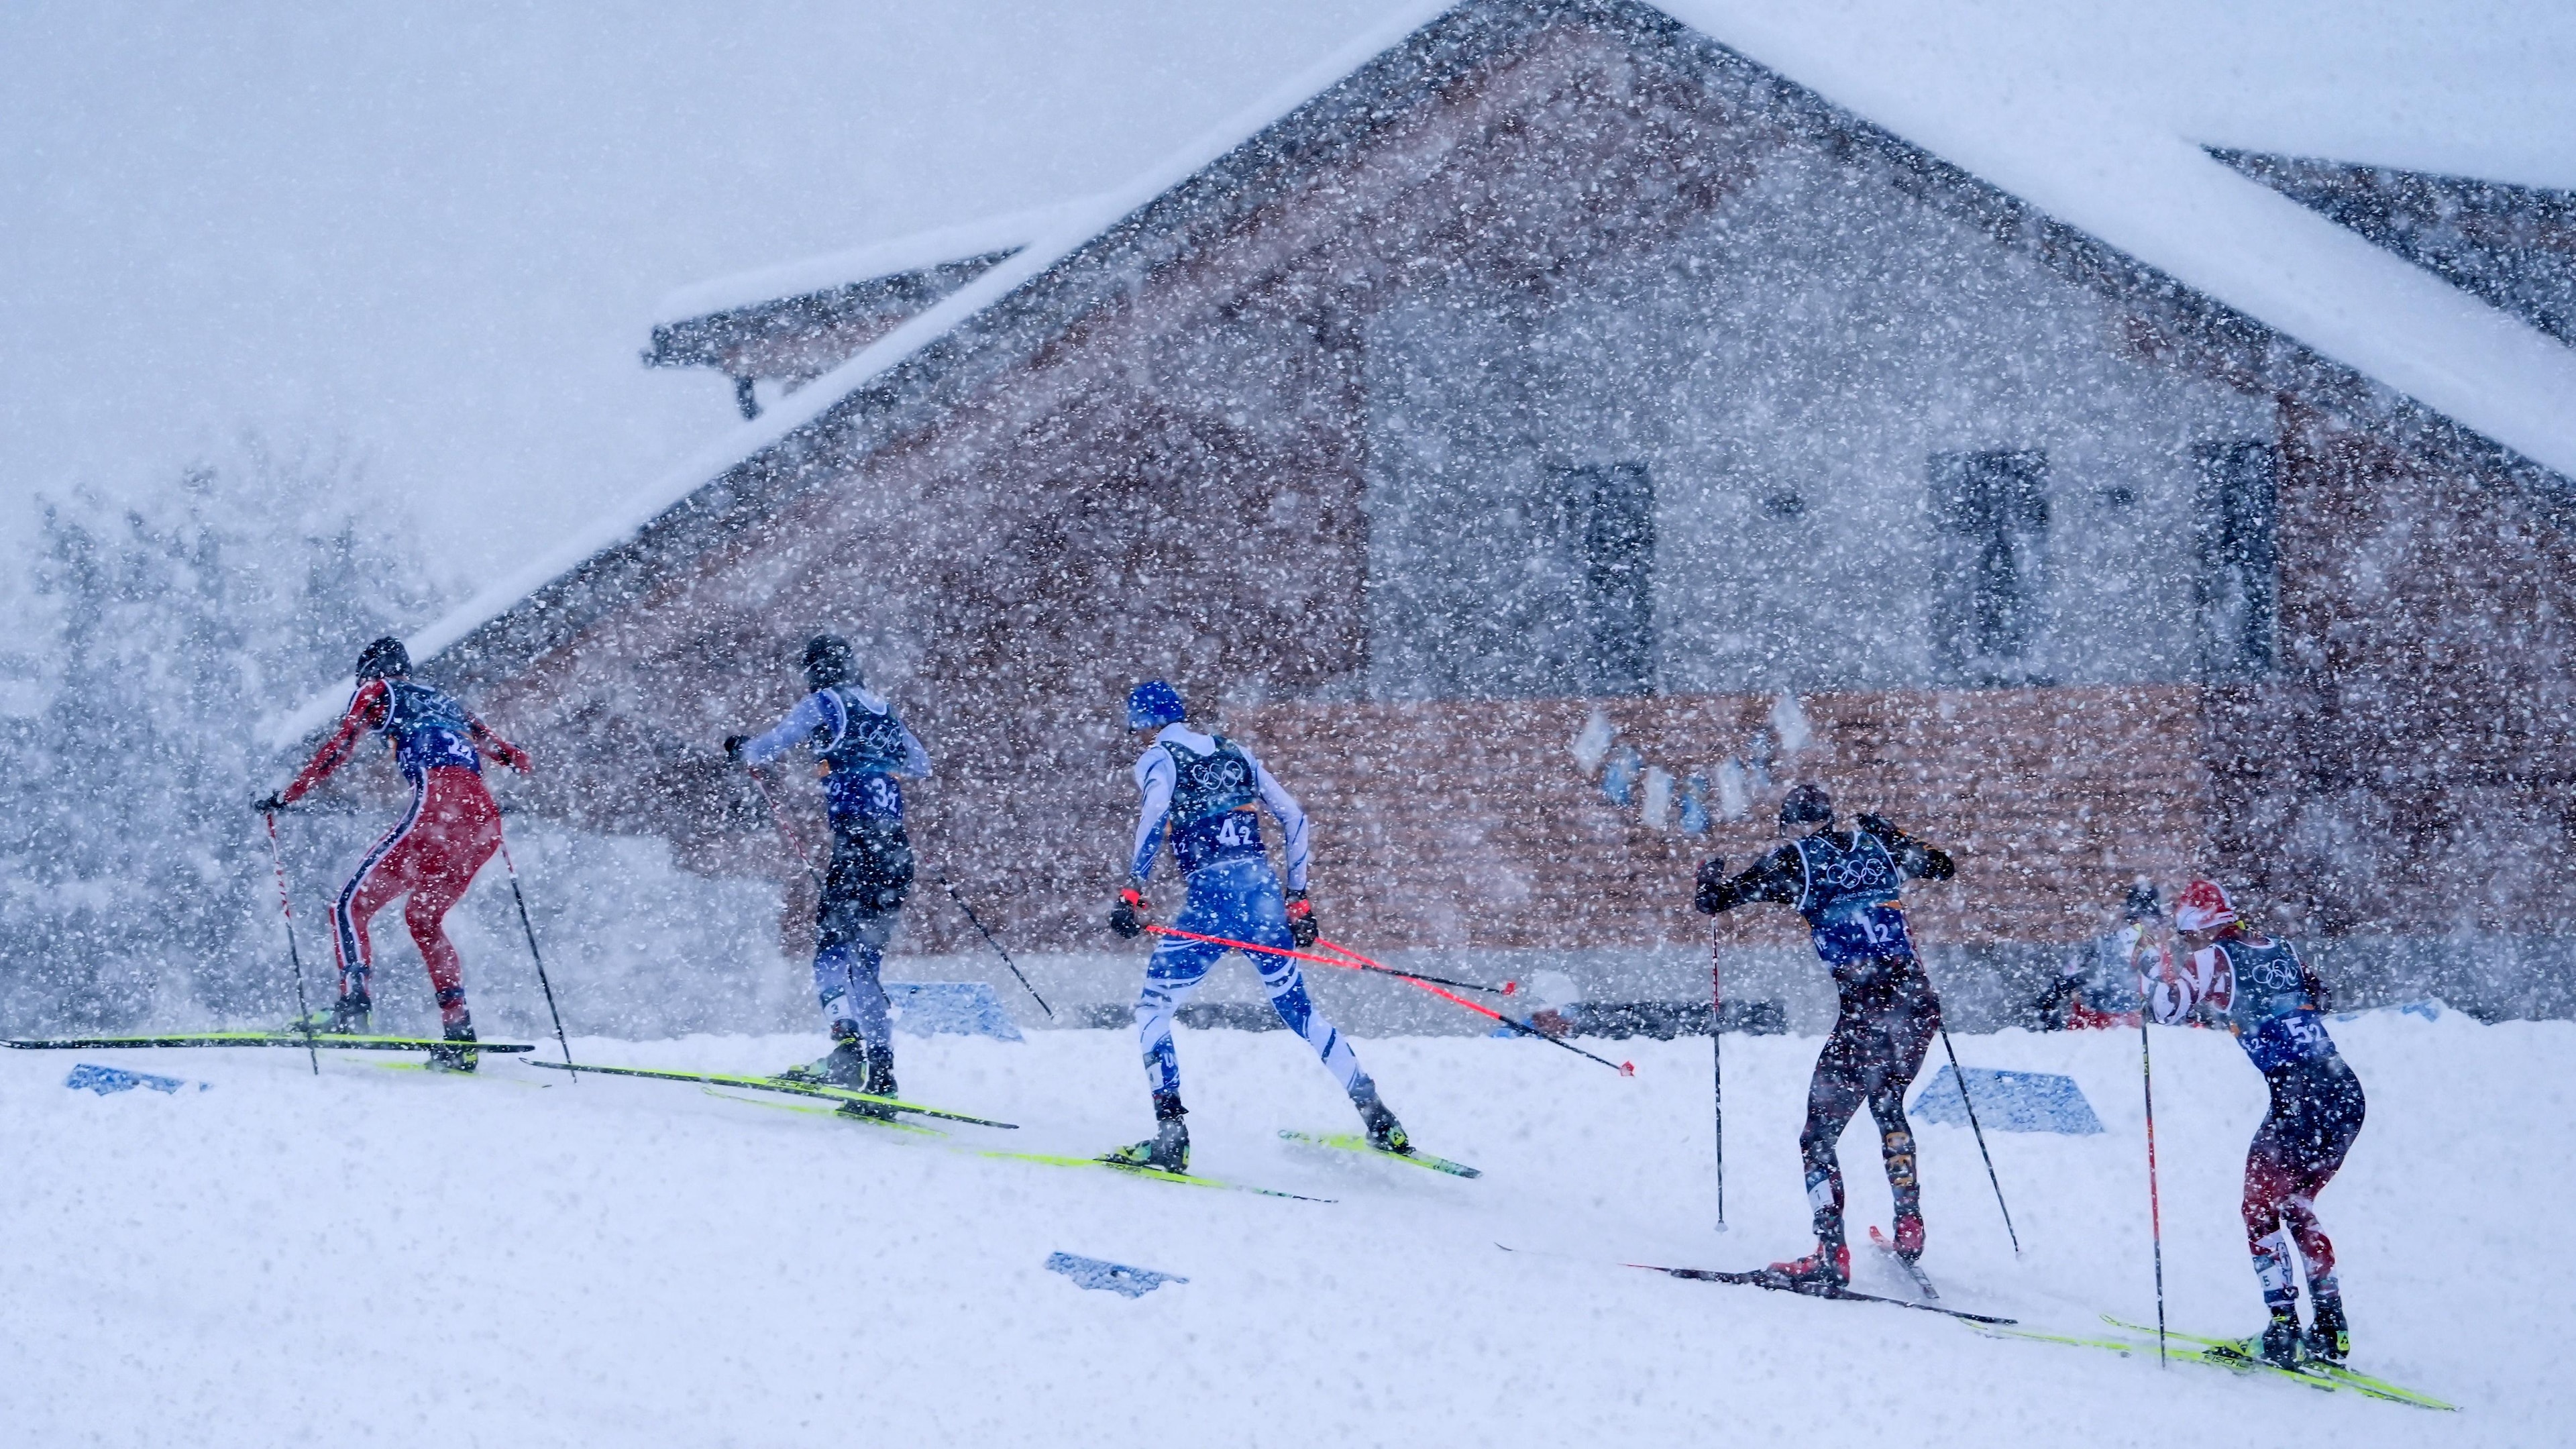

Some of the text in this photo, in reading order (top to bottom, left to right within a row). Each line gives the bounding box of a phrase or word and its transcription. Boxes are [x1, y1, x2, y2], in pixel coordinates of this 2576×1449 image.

[1217, 818, 1254, 847] 42
[1856, 915, 1894, 944] 12
[2282, 1016, 2328, 1043] 52
[2263, 1275, 2271, 1287] 5
